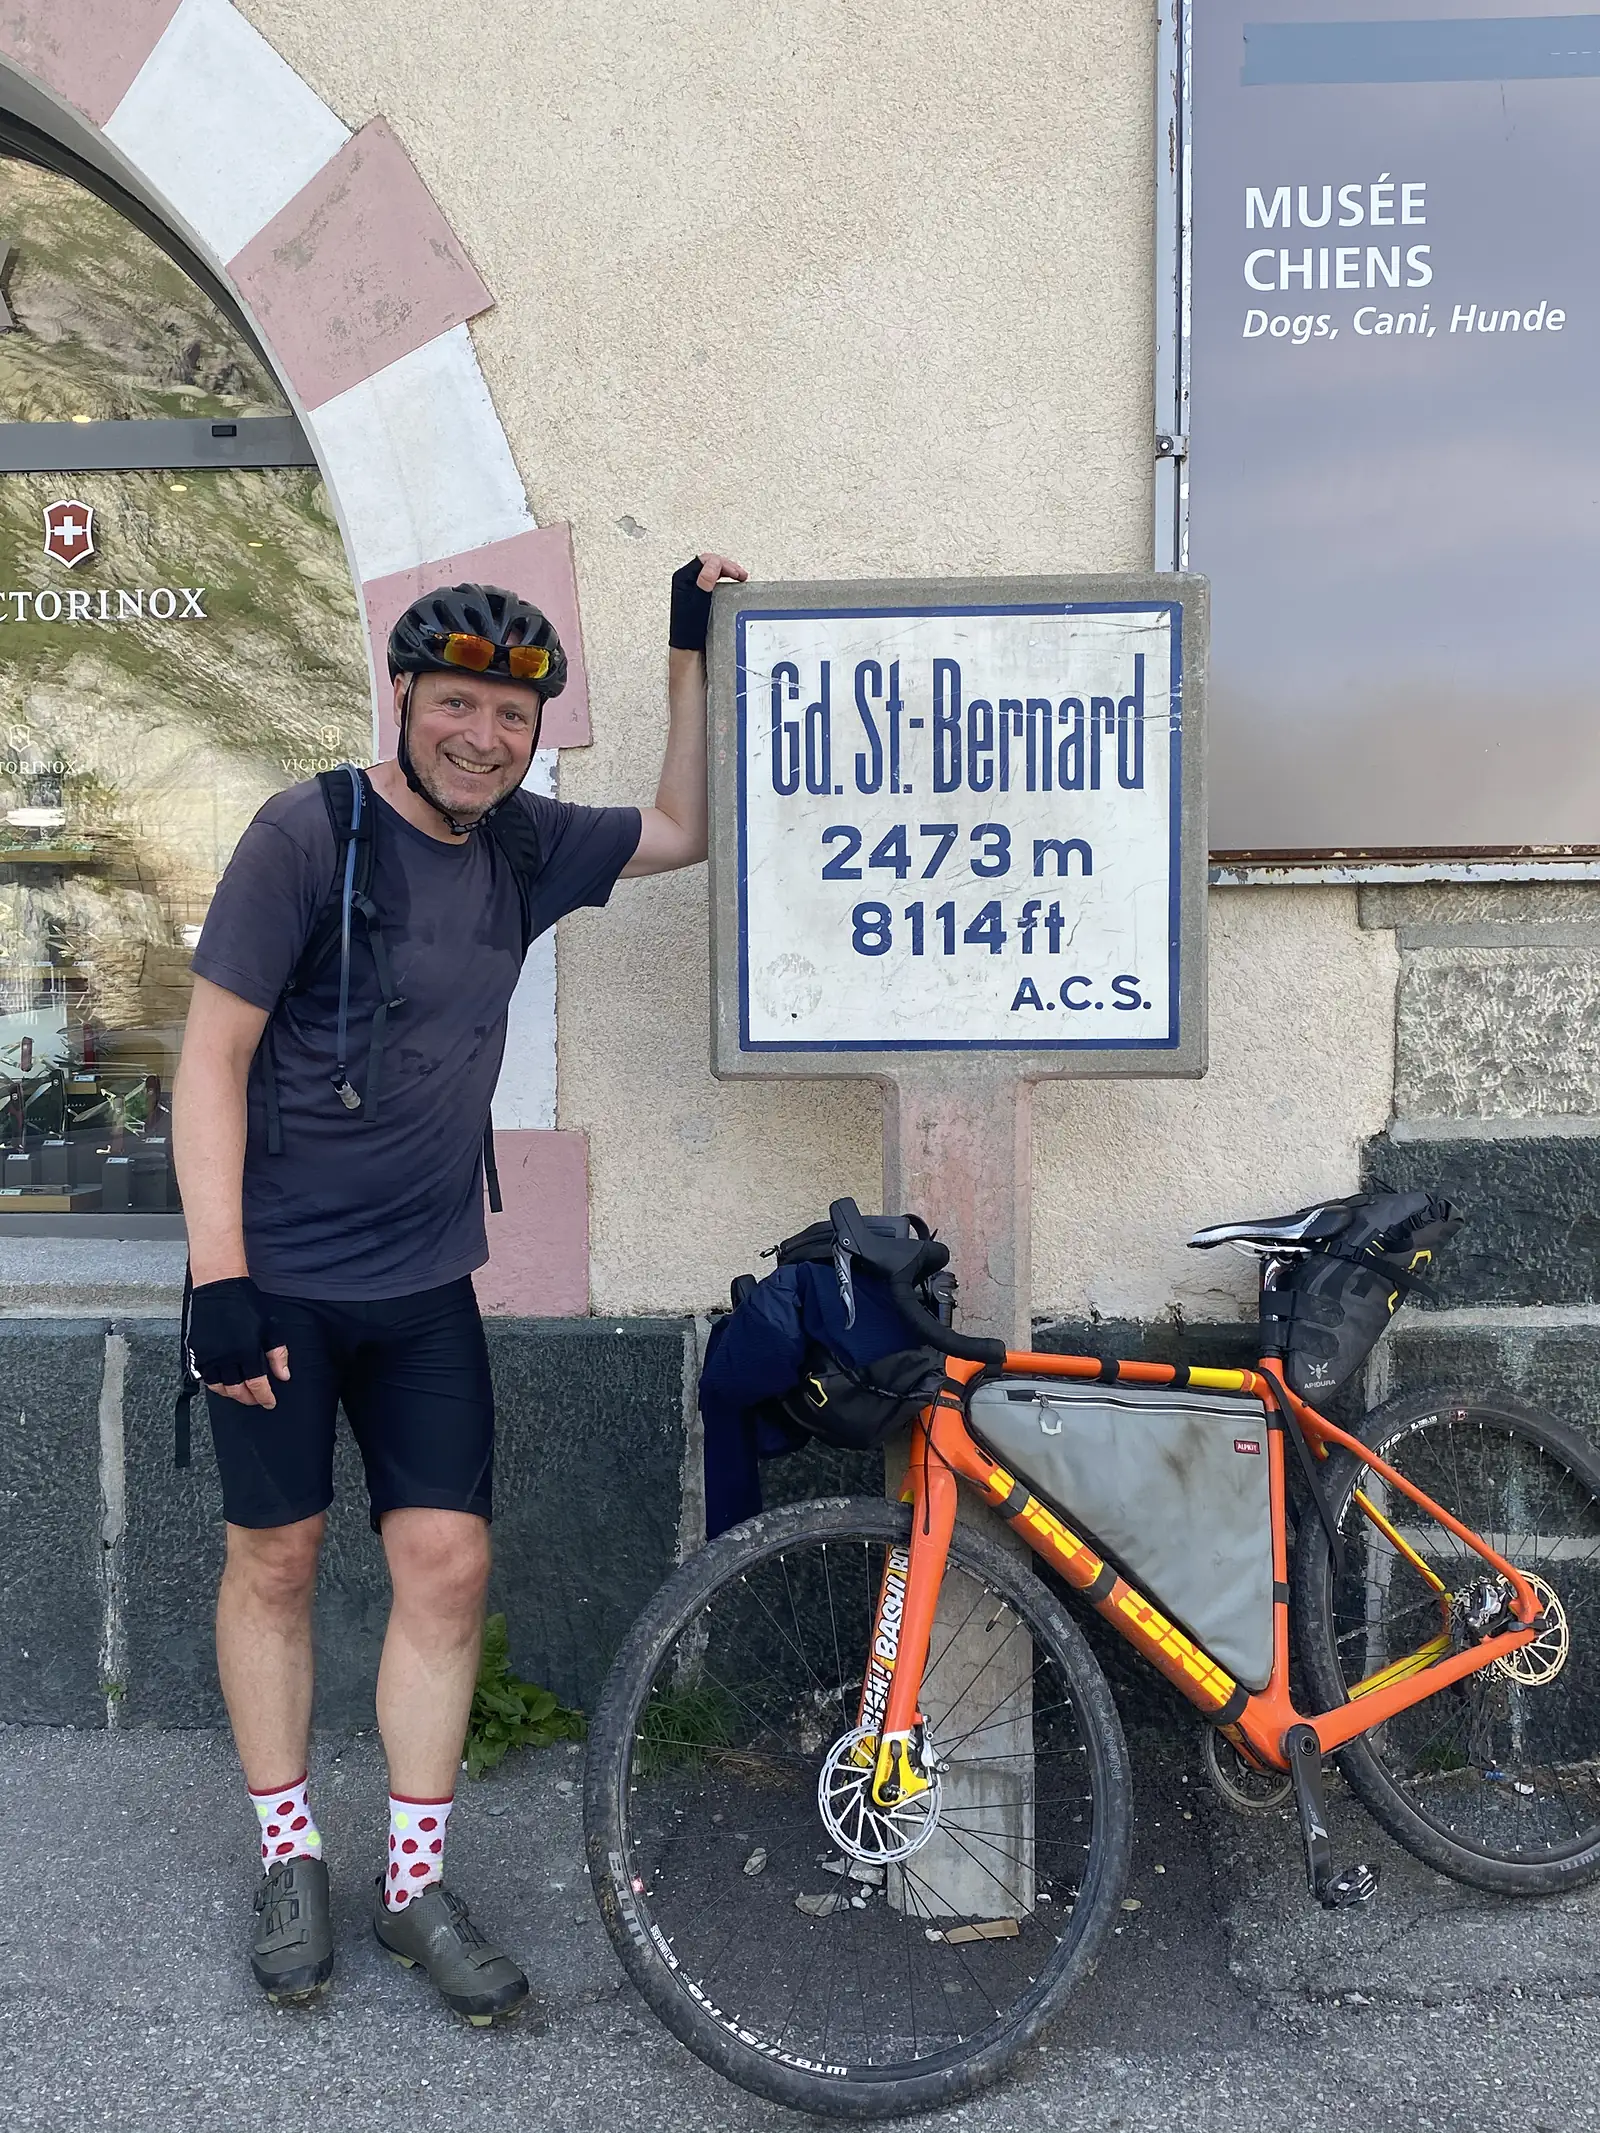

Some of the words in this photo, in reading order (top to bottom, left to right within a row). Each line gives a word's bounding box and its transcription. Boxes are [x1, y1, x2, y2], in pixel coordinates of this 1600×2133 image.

[1245, 172, 1428, 230] MUSÉE
[1242, 244, 1434, 291] CHIENS
[1241, 307, 1340, 345] Dogs,
[1352, 303, 1437, 340] Cani,
[1448, 300, 1567, 334] Hunde
[770, 659, 844, 797] Gd.
[821, 822, 1012, 881] 2473
[1032, 837, 1094, 878] m
[1009, 974, 1153, 1012] A.C.S.
